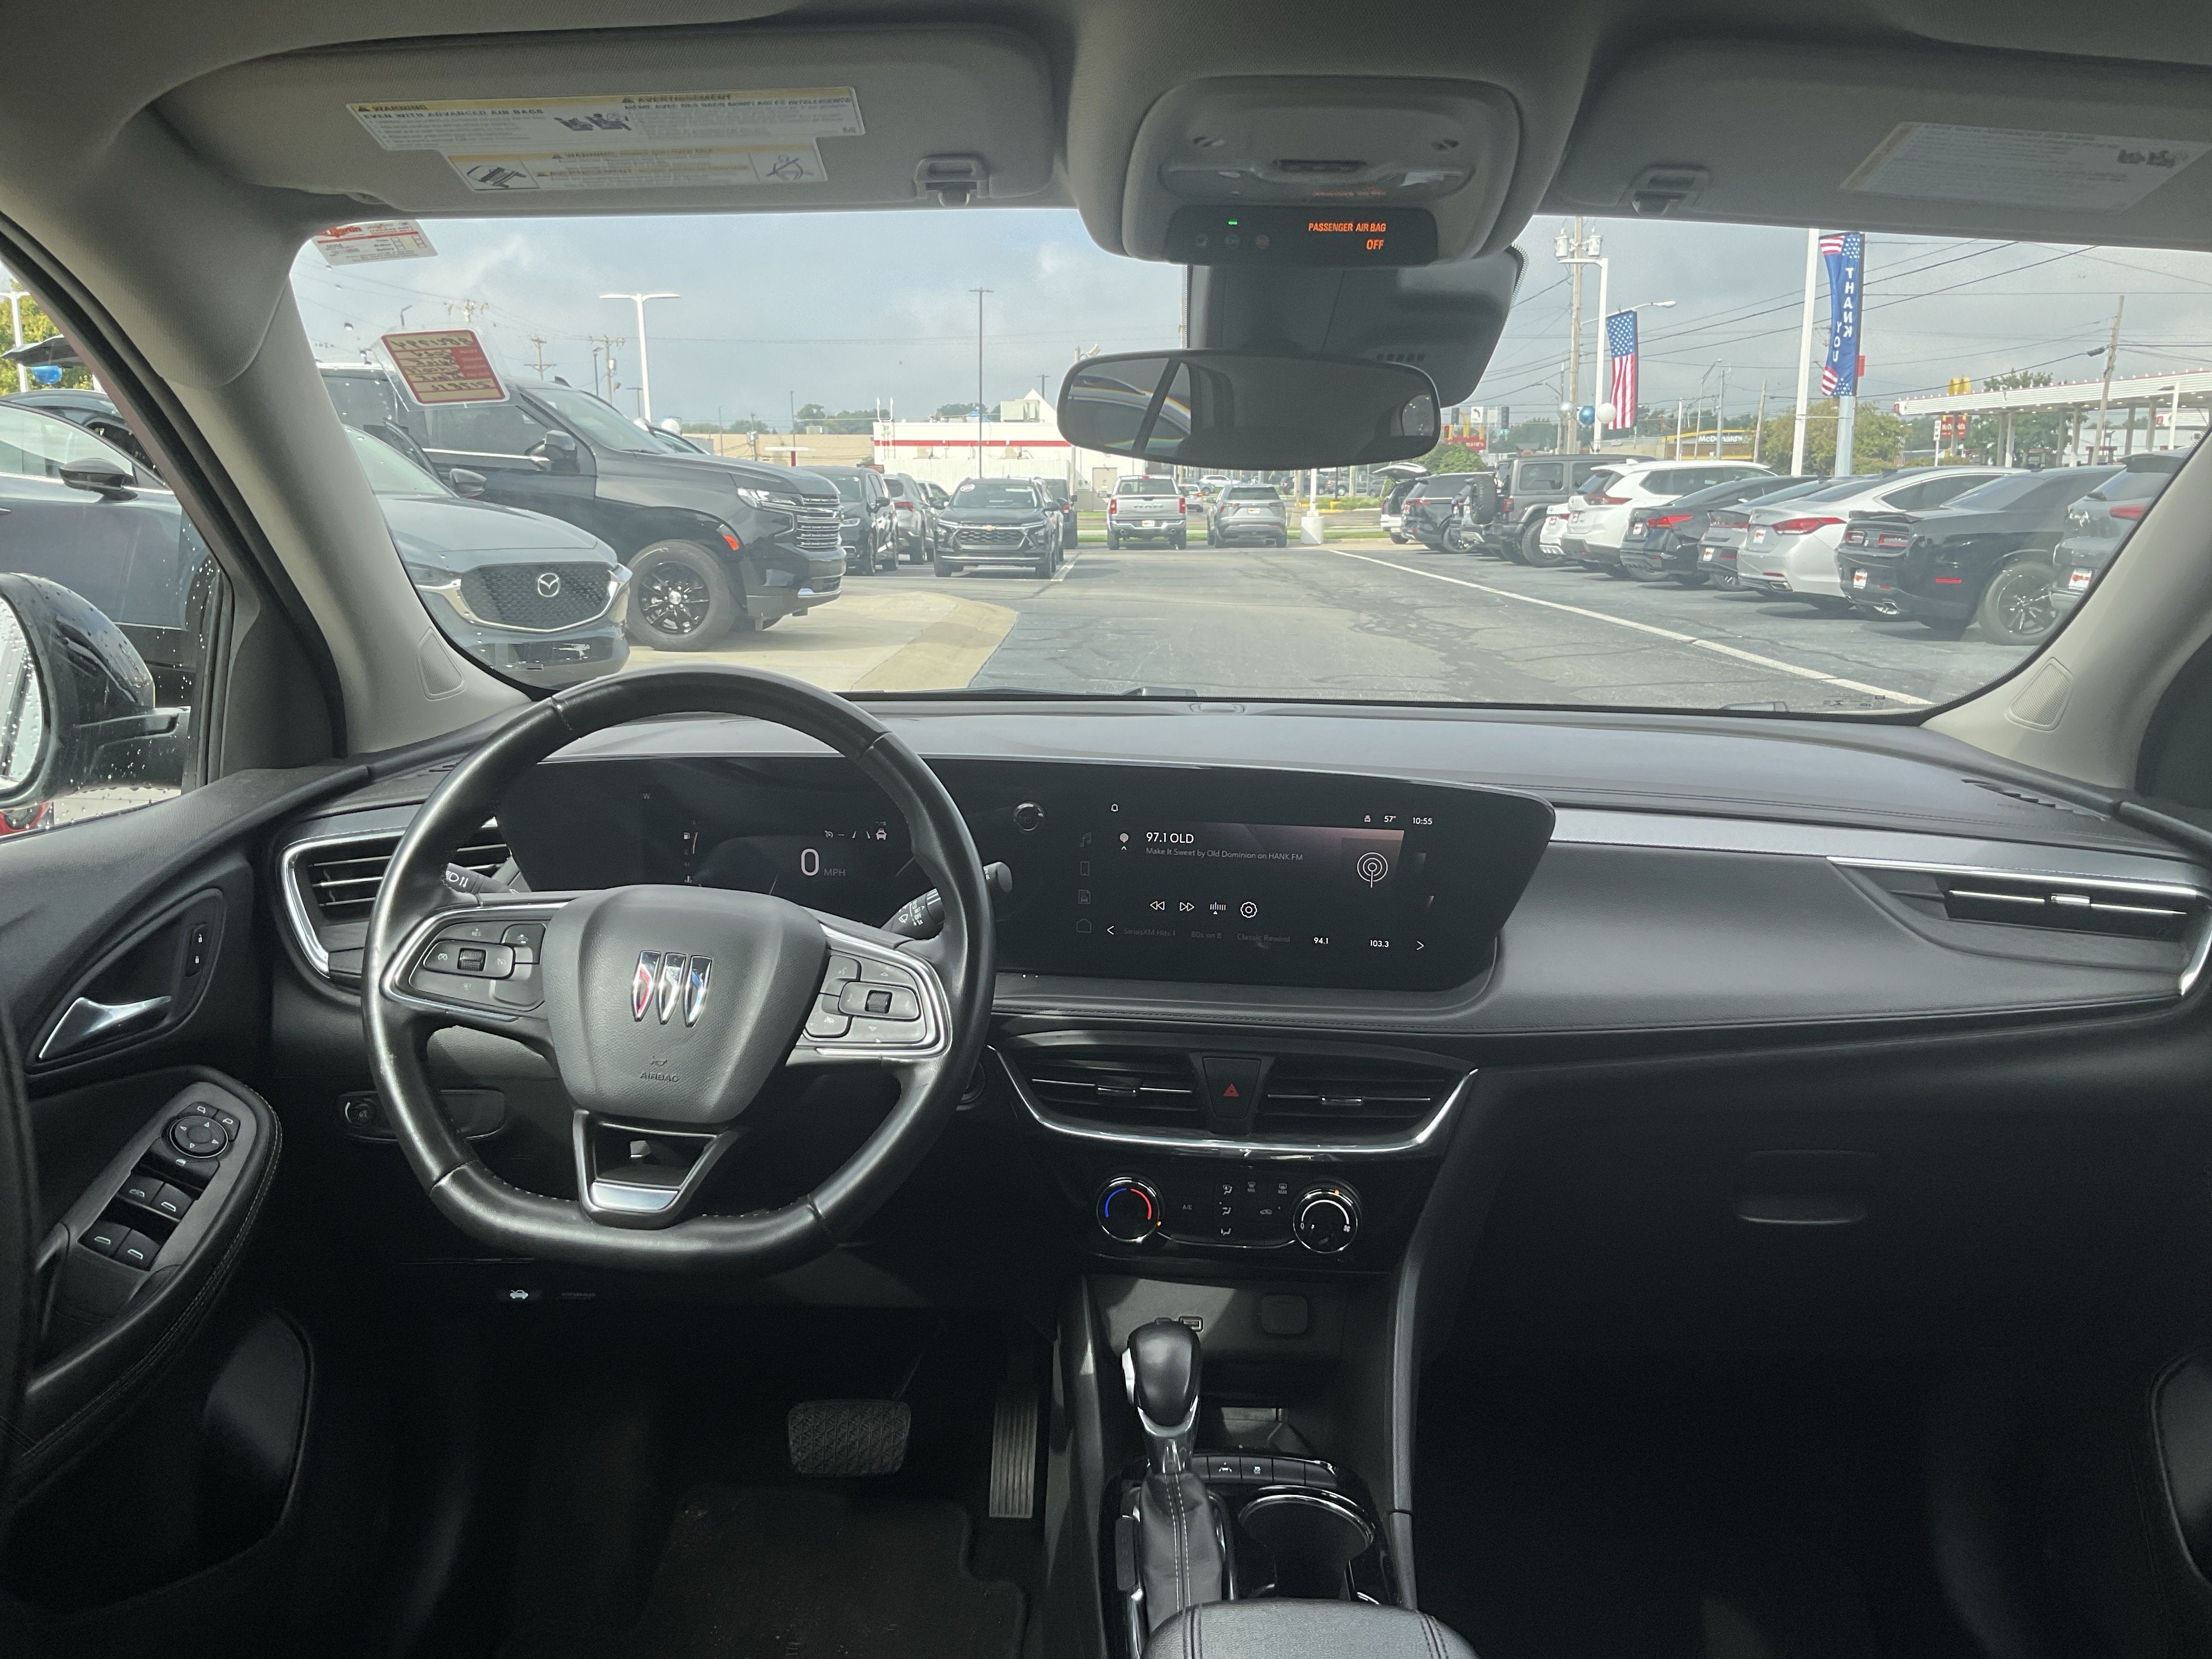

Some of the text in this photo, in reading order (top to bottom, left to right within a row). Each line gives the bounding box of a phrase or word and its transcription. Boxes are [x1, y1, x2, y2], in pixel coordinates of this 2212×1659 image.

[1308, 222, 1386, 232] PASSENGER AIR BAG
[1366, 239, 1384, 250] OFF
[1413, 817, 1433, 825] 10:55
[1146, 832, 1194, 844] 97.1 OLD
[1197, 849, 1206, 859] by
[1222, 850, 1256, 859] Dominion
[801, 848, 820, 876] 0
[1237, 933, 1290, 943] Classic Rewind
[1370, 940, 1389, 948] 103.3
